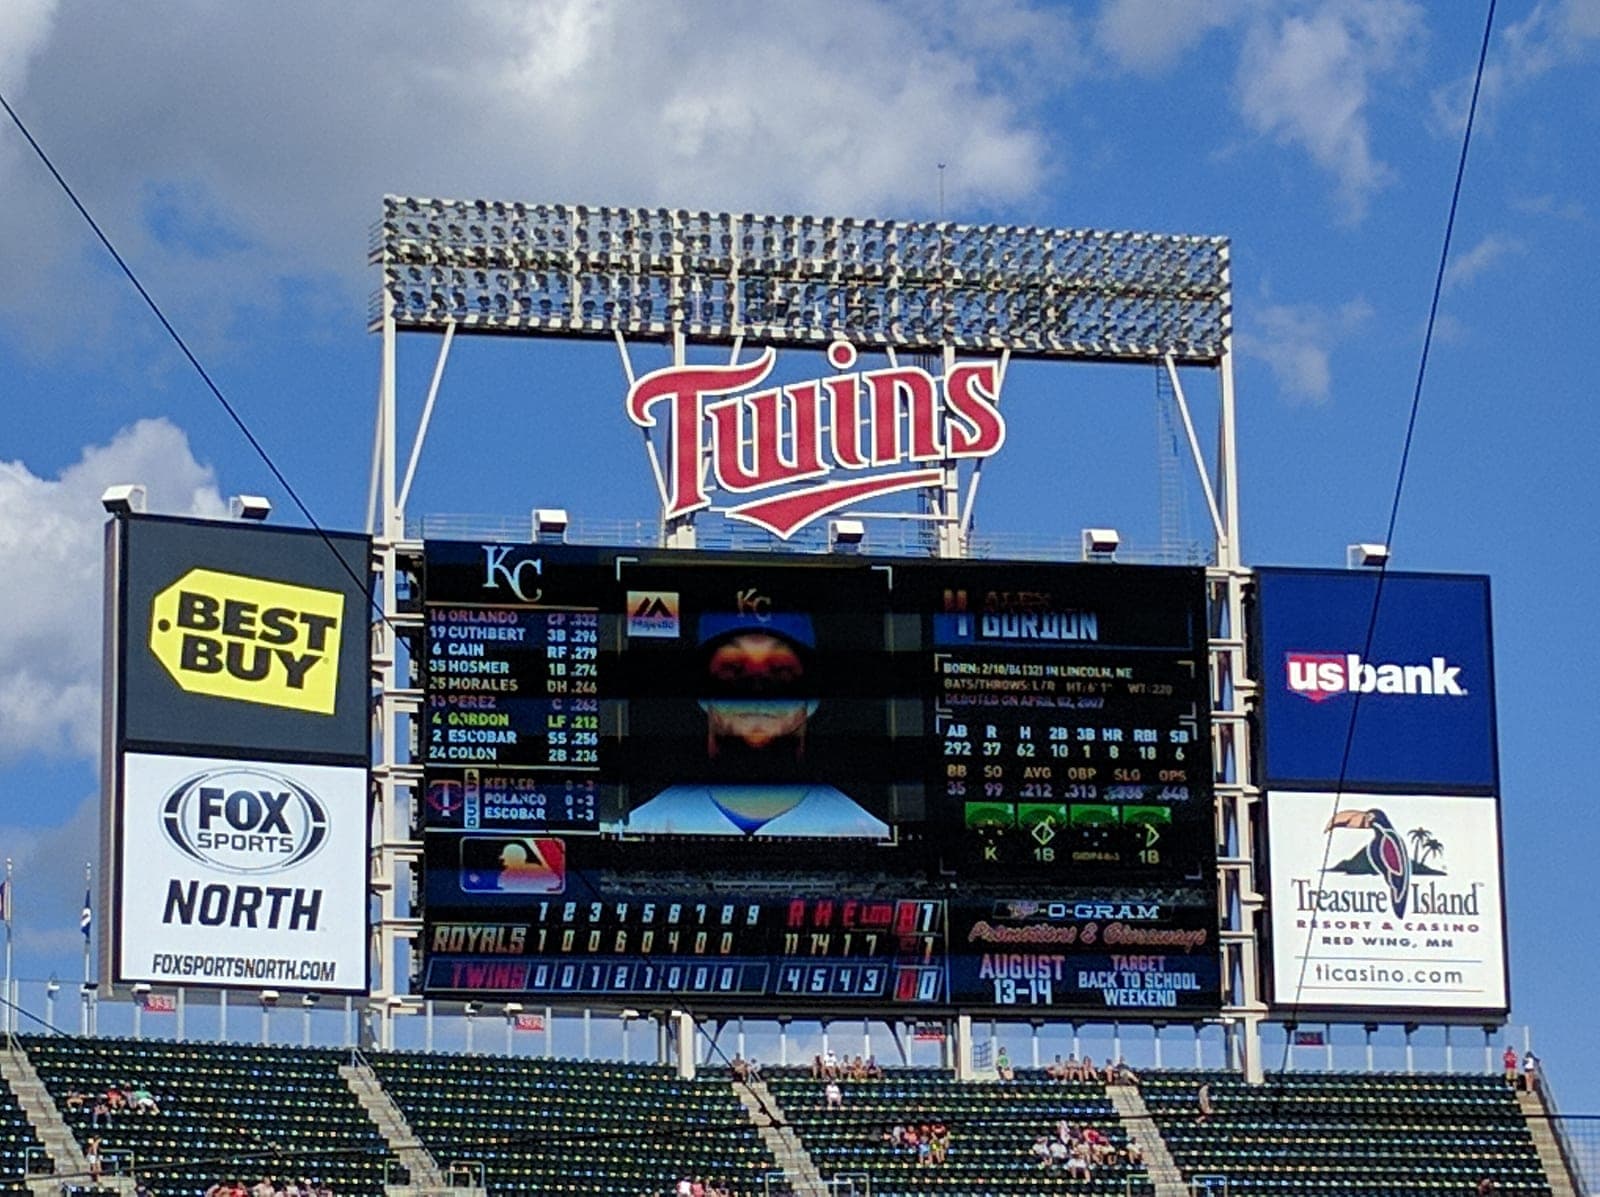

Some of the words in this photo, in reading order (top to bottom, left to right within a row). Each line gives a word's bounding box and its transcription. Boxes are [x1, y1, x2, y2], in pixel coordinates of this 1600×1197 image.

[627, 341, 1005, 519] Twins
[482, 545, 542, 601] KC
[177, 591, 337, 652] BEST
[430, 609, 445, 621] 16
[449, 610, 517, 624] ORLANDO
[430, 626, 446, 638] 19
[449, 626, 525, 640] CUTHBERT
[548, 630, 566, 641] 3B
[433, 643, 441, 655] 6
[449, 644, 484, 656] CAIN
[548, 646, 566, 658] RF
[180, 633, 323, 689] BUY
[429, 660, 446, 672] 35
[449, 661, 509, 673] HOSMER
[550, 664, 566, 676] 1B
[944, 663, 980, 673] BORN:
[1046, 666, 1058, 676] IN
[1060, 666, 1114, 678] LINCOLN,
[1116, 667, 1132, 678] NE
[449, 678, 518, 691] MORALES
[547, 680, 567, 693] DH
[430, 695, 446, 707] 13
[449, 696, 496, 708] PEREZ
[552, 699, 562, 710] C
[432, 712, 441, 725] 4
[548, 715, 566, 728] LF
[571, 716, 597, 728] .212
[433, 730, 442, 742] 2
[448, 730, 517, 744] ESCOBAR
[548, 732, 566, 744] SS
[571, 733, 598, 745] .256
[947, 725, 968, 737] AB
[986, 726, 997, 738] R
[1020, 726, 1031, 739] H
[1050, 727, 1068, 740] 2B
[1077, 728, 1095, 740] 3B
[1103, 729, 1122, 741] HR
[1134, 729, 1157, 742] RBI
[1170, 730, 1188, 743] SB
[429, 746, 446, 758] 24
[449, 748, 496, 760] COLON
[549, 749, 566, 762] 2B
[944, 742, 971, 755] 292
[983, 742, 1000, 755] 37
[1017, 744, 1034, 757] 62
[1051, 745, 1068, 757] 10
[1084, 746, 1090, 758] 1
[1109, 746, 1119, 758] 8
[1140, 747, 1156, 759] 18
[1176, 748, 1184, 760] 6
[947, 765, 967, 777] BB
[984, 766, 1002, 778] SO
[1024, 767, 1051, 779] AVG
[1068, 767, 1096, 780] OBP
[1114, 768, 1141, 781] SLG
[1159, 769, 1187, 782] OPS
[484, 793, 546, 804] POLANCO
[947, 784, 966, 796] 35
[985, 784, 1002, 796] 99
[1020, 785, 1052, 797] .212
[1065, 785, 1097, 798] .313
[198, 788, 291, 834] FOX
[484, 808, 546, 820] ESCOBAR
[197, 833, 294, 854] SPORTS
[985, 848, 998, 860] K
[1034, 849, 1054, 861] 1B
[1139, 850, 1159, 863] 1B
[163, 879, 322, 931] NORTH
[1291, 879, 1387, 913] Treasure
[1412, 881, 1479, 916] Island
[539, 902, 548, 921] 1
[563, 903, 576, 921] 2
[590, 903, 602, 922] 3
[616, 904, 627, 922] 4
[643, 904, 655, 922] 5
[668, 904, 681, 923] 6
[696, 904, 706, 924] 7
[721, 905, 734, 925] 8
[747, 905, 760, 925] 9
[789, 900, 804, 926] R
[814, 901, 832, 926] H
[843, 901, 858, 926] E
[923, 903, 934, 932] 1
[1080, 923, 1098, 944] &
[1297, 920, 1371, 930] RESORT
[1382, 922, 1393, 930] &
[1405, 923, 1479, 932] CASINO
[432, 926, 527, 952] ROYALS
[539, 930, 547, 951] 1
[562, 930, 575, 952] 0
[588, 930, 601, 952] 0
[615, 930, 627, 952] 6
[642, 930, 653, 953] 0
[669, 931, 679, 953] 4
[696, 932, 706, 953] 0
[721, 932, 732, 954] 0
[785, 934, 798, 954] 11
[811, 934, 830, 955] 14
[844, 934, 851, 956] 1
[866, 934, 877, 956] 7
[924, 937, 934, 963] 1
[1322, 936, 1354, 946] RED
[1363, 937, 1417, 948] WING,
[1426, 939, 1453, 948] MN
[152, 954, 336, 982] FOXSPORTSNORTH.COM
[980, 954, 1065, 979] AUGUST
[1111, 955, 1165, 971] TARGET
[451, 963, 526, 989] TWINS
[535, 965, 548, 987] 0
[562, 966, 575, 988] 0
[592, 966, 599, 988] 1
[615, 966, 627, 988] 2
[645, 967, 653, 988] 1
[668, 967, 680, 989] 0
[695, 968, 707, 989] 0
[721, 968, 733, 989] 0
[788, 969, 800, 991] 4
[812, 969, 826, 990] 5
[840, 970, 851, 991] 4
[864, 970, 879, 991] 3
[1079, 972, 1117, 988] BACK
[1122, 972, 1140, 988] TO
[1145, 973, 1200, 989] SCHOOL
[1316, 964, 1462, 984] ticasino.com
[920, 971, 936, 999] 0
[994, 979, 1052, 1004] 13-14
[1104, 989, 1176, 1006] WEEKEND
